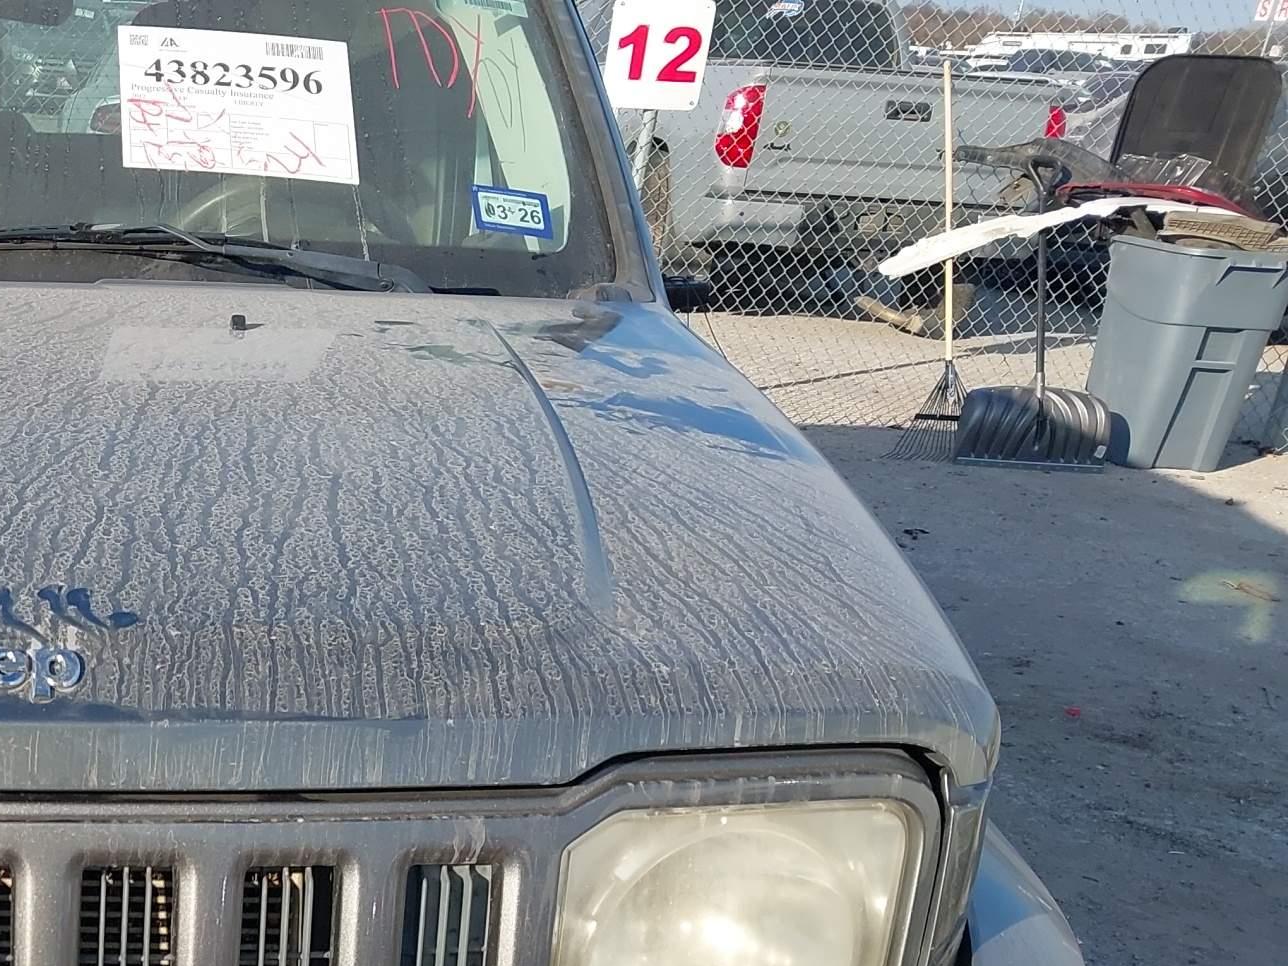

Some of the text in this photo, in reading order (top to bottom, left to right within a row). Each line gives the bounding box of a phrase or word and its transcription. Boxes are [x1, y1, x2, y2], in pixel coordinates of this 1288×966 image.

[617, 24, 702, 83] 12
[144, 58, 323, 95] 43823596
[187, 87, 226, 97] Casualty
[230, 89, 274, 100] Insurance
[518, 207, 541, 225] 26
